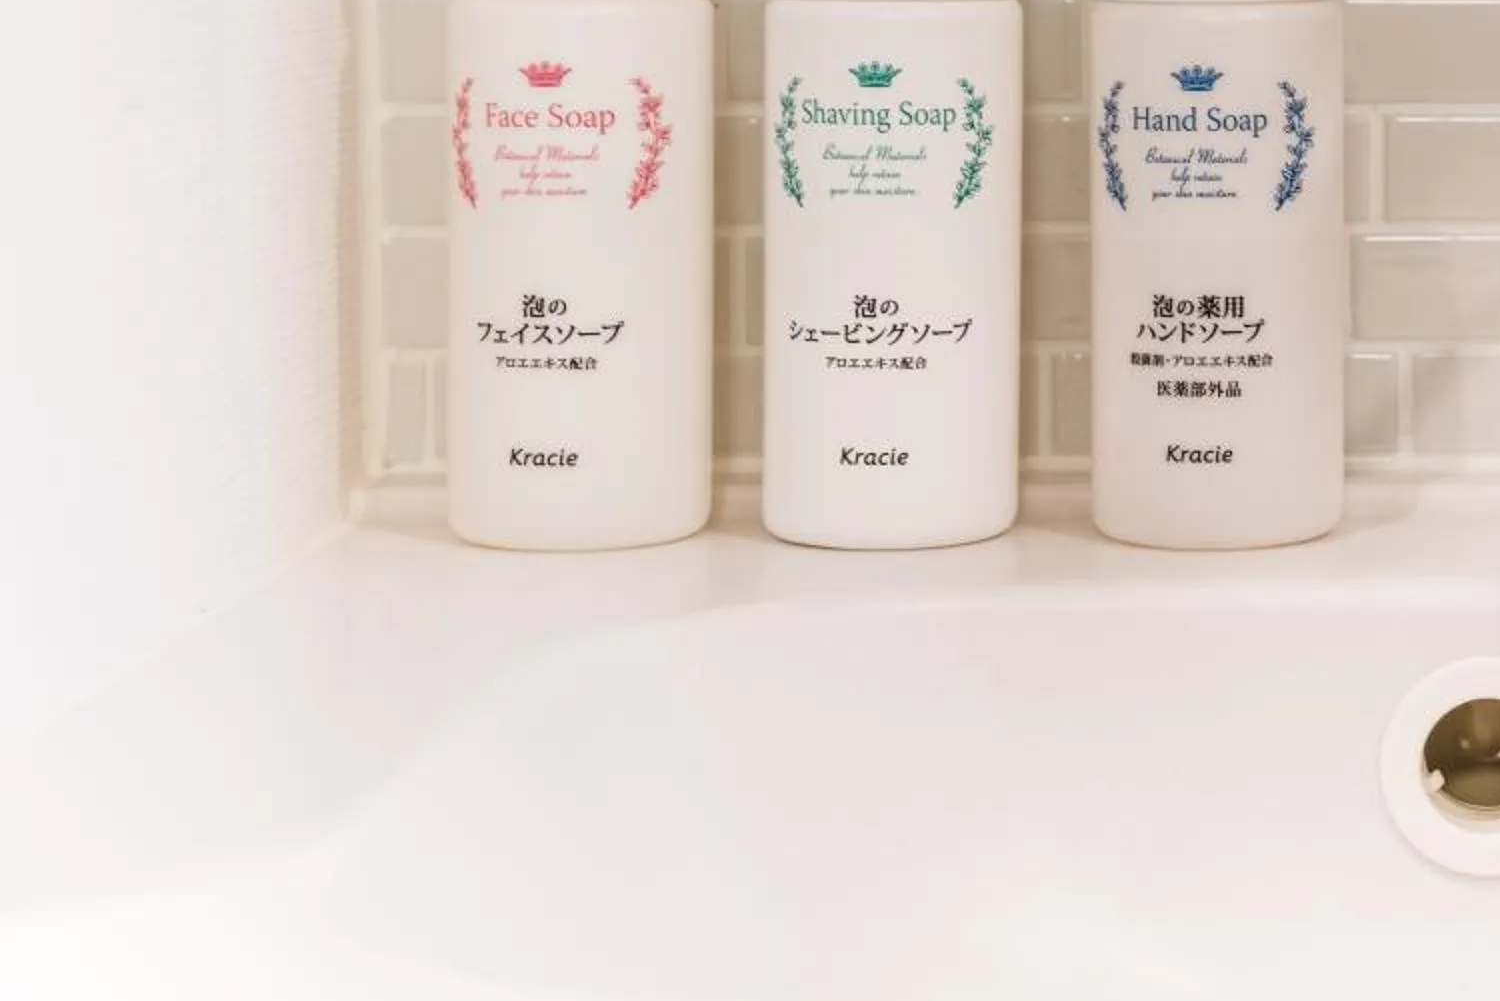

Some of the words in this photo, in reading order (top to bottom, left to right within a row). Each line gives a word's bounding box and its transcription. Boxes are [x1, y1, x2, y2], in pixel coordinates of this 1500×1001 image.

[485, 103, 539, 128] Face
[548, 103, 616, 135] Soap
[801, 98, 891, 134] Shaving
[899, 101, 957, 132] Soap
[1132, 106, 1197, 132] Hand
[1206, 107, 1268, 138] Soap
[522, 295, 567, 318] 泡の
[853, 295, 899, 319] 泡の
[1152, 295, 1245, 319] 泡の薬用
[477, 317, 624, 345] フェイスソープ
[790, 317, 973, 346] シェービングソープ
[1137, 316, 1264, 343] ハンドソープ
[496, 356, 598, 371] アロエエキス配合
[825, 356, 927, 370] アロエエキス配合
[1157, 380, 1242, 398] 医薬部外品
[509, 448, 578, 468] Kracie
[840, 447, 909, 466] Kracie
[1166, 445, 1233, 463] Kracie
